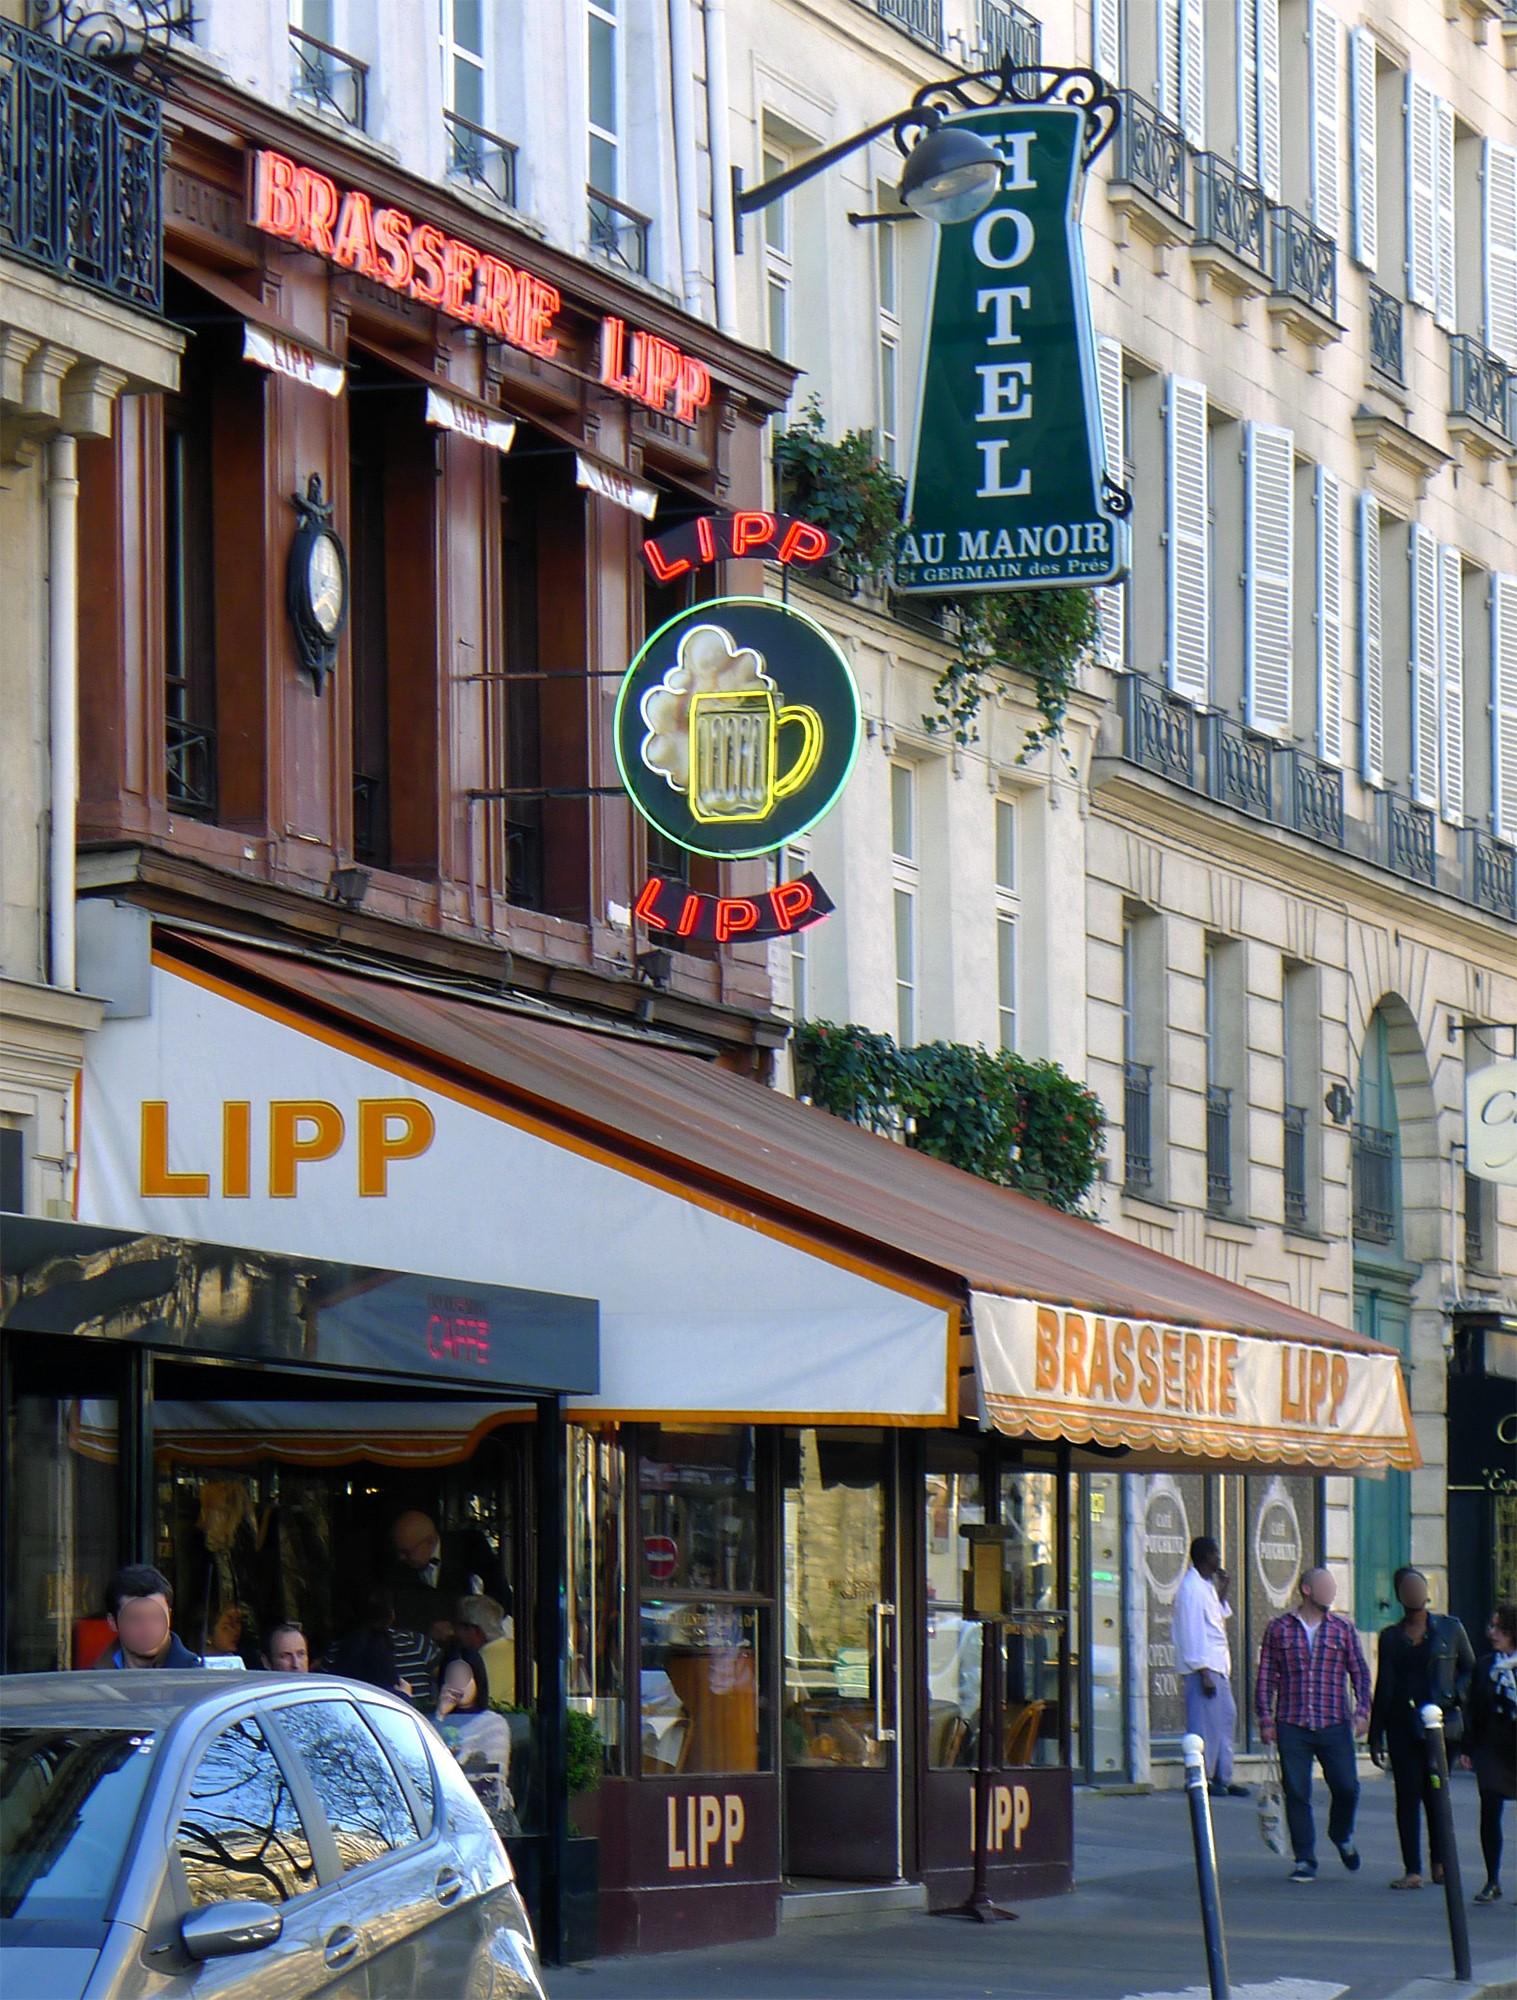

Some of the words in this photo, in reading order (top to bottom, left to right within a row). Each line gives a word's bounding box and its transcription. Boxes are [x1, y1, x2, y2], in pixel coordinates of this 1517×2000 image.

[256, 150, 560, 358] BRASSERIE
[601, 316, 711, 423] LIPP
[972, 131, 1038, 497] HOTEL
[271, 334, 315, 380] LIPP
[449, 397, 488, 438] LIPP
[597, 463, 633, 505] LIPP
[643, 510, 828, 582] LIPP
[898, 532, 946, 564] AU
[958, 521, 1110, 562] MANOIR
[898, 571, 916, 584] St
[923, 562, 1022, 582] GERMAIN
[1029, 561, 1060, 576] des
[634, 876, 814, 942] LIPP
[140, 1097, 436, 1199] LIPP
[1035, 1304, 1239, 1417] BRASSERIE
[1281, 1344, 1349, 1428] LIPP
[667, 1793, 746, 1870] LIPP
